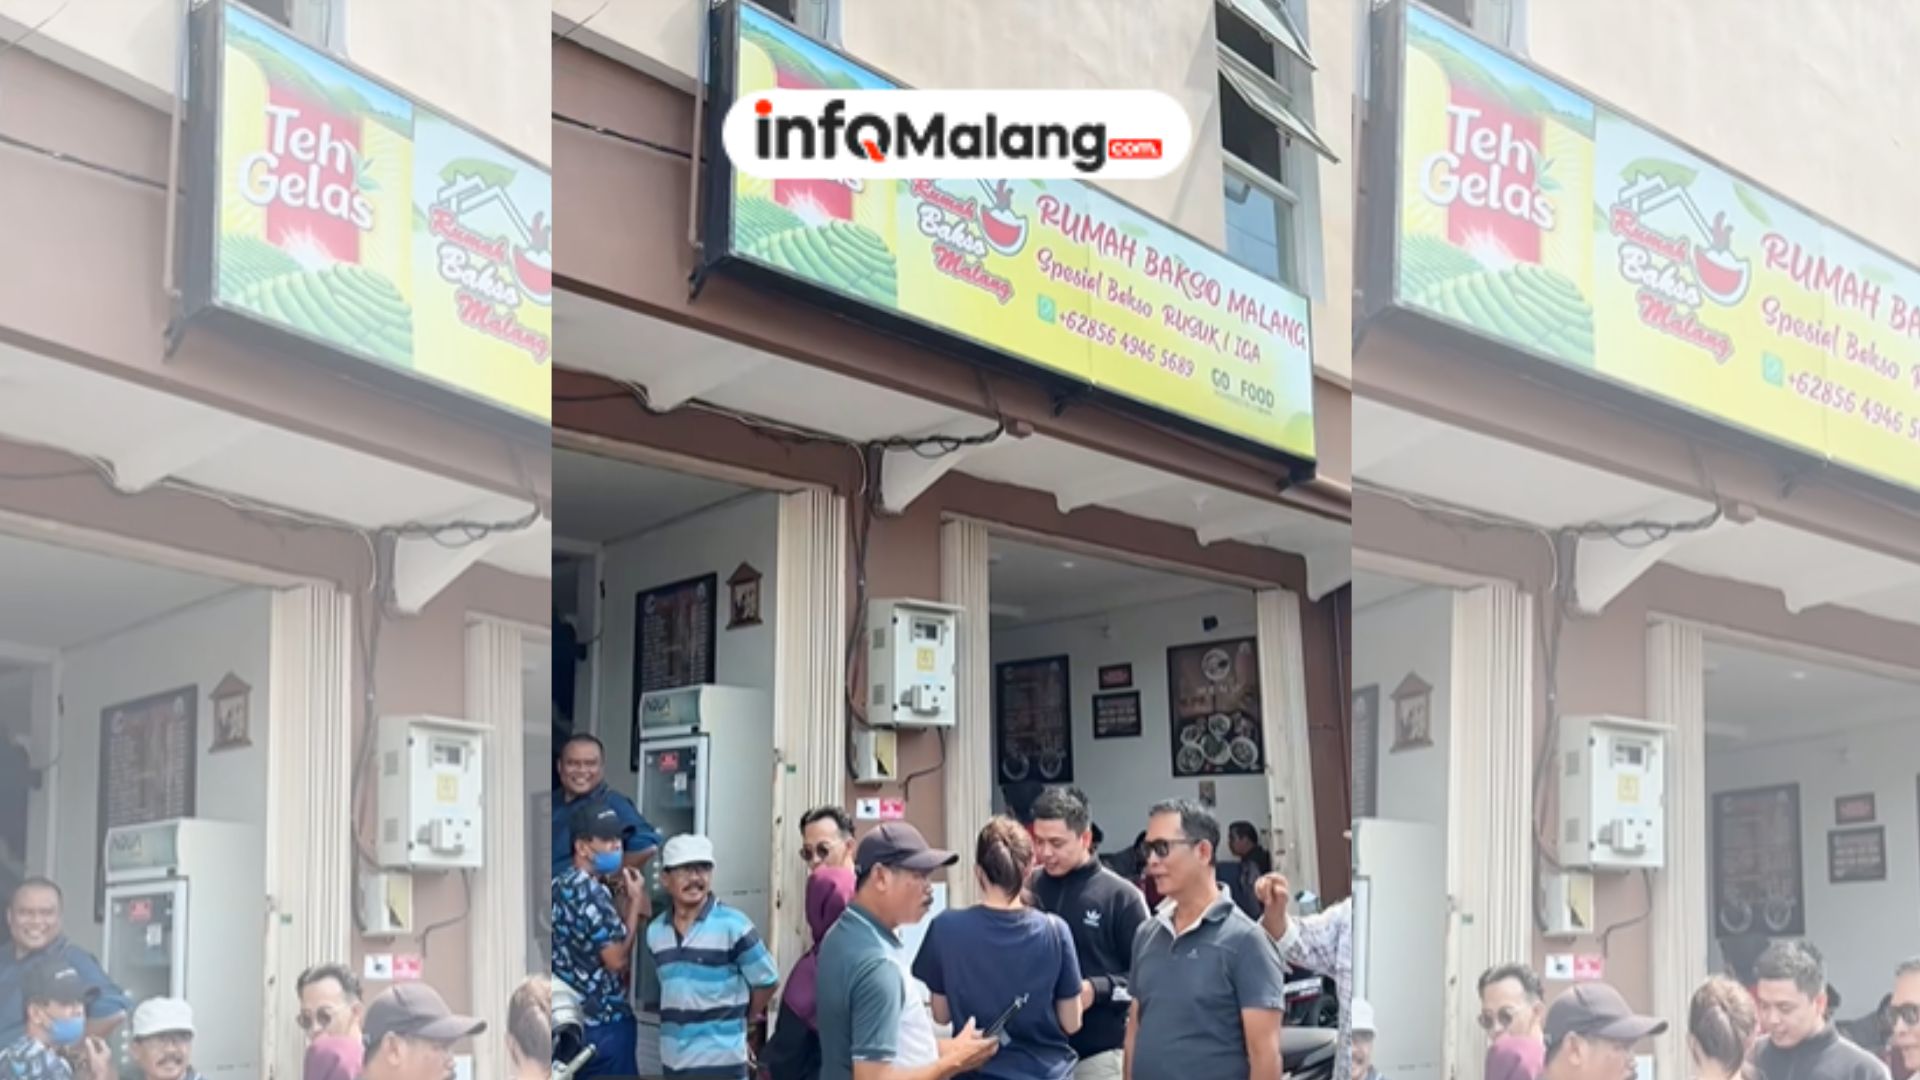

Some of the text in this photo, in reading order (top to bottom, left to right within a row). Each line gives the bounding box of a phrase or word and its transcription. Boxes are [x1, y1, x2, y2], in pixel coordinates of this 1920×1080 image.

[266, 105, 346, 174] Teh
[1446, 105, 1527, 174] Teh
[239, 152, 374, 231] Gelas
[1420, 152, 1556, 231] Gelas
[917, 203, 988, 258] Bakso
[933, 244, 1014, 304] Malang
[1036, 194, 1307, 351] RUMAH BAKSO MALANG
[1037, 248, 1103, 298] Spesial
[1107, 276, 1153, 318] Bakso
[1162, 304, 1221, 353] RUSUK
[1234, 336, 1261, 364] IGA
[1760, 232, 1881, 320] RUMAH
[1060, 309, 1116, 347] +62856
[1120, 331, 1156, 363] 4946
[1761, 295, 1839, 355] Spesial
[1845, 331, 1899, 380] Bakso
[1240, 380, 1275, 409] FOOD
[1788, 371, 1856, 414] +62856
[1860, 397, 1904, 433] 4946
